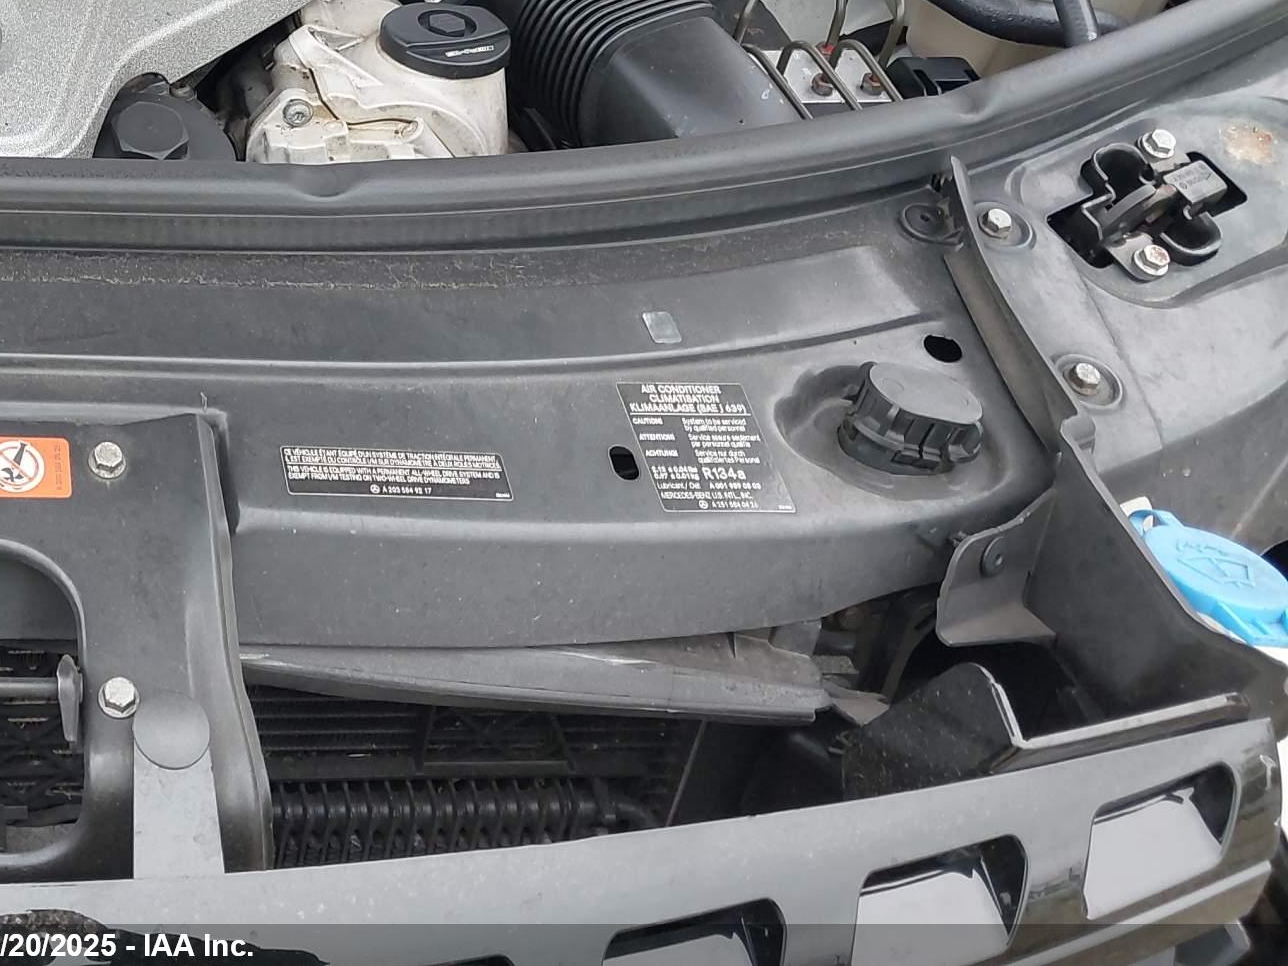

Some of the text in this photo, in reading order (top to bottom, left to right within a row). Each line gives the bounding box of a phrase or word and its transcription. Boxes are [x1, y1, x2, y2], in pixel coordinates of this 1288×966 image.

[642, 385, 722, 394] AIR CONDITIONER
[629, 403, 696, 414] KLIMAANLAGE
[702, 466, 746, 480] R134a
